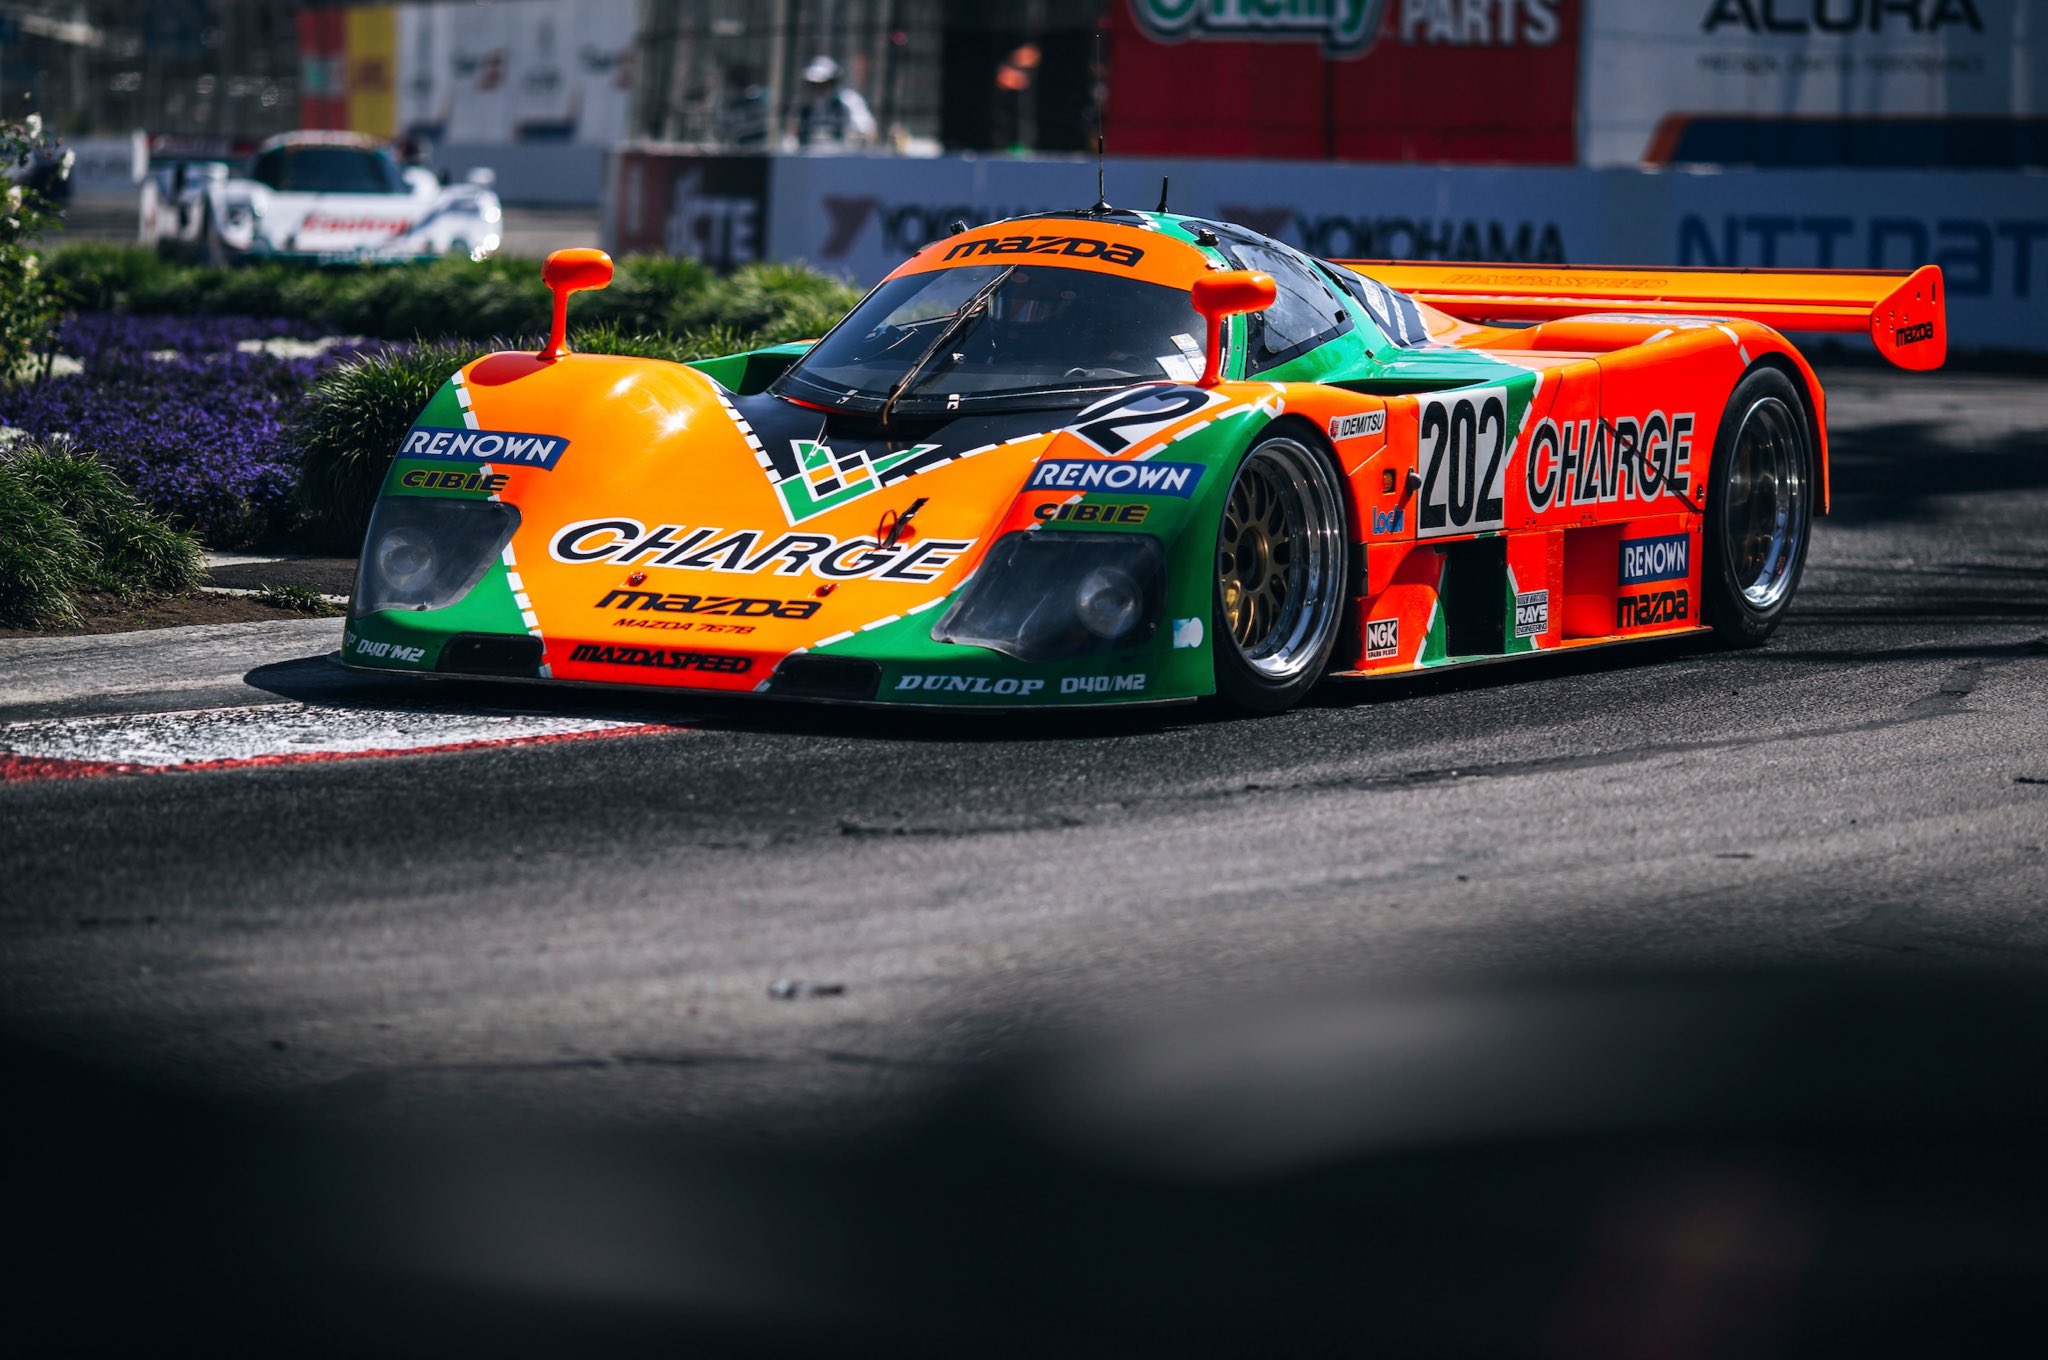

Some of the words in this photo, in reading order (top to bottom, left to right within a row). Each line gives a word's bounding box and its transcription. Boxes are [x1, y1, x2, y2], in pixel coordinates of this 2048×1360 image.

[1403, 0, 1560, 45] PARTS
[1700, 0, 1985, 34] ACURA
[943, 235, 1145, 268] mazda
[1296, 212, 1568, 263] YOKOHAMA
[1678, 213, 1854, 268] NTT
[1896, 322, 1934, 347] mazda
[1341, 413, 1384, 437] IDEMITSU
[402, 431, 557, 463] RENOWN
[1420, 396, 1504, 529] 202
[1526, 409, 1696, 514] CHARGE
[401, 469, 511, 492] CIBIE
[1031, 463, 1192, 492] RENOWN
[1033, 502, 1150, 525] CIBIE
[549, 517, 979, 584] CHARGE
[1623, 539, 1686, 578] RENOWN
[595, 589, 823, 620] mazda
[1517, 604, 1547, 625] RAYS
[1616, 588, 1689, 628] mazda
[612, 618, 694, 631] MAZDA
[696, 623, 756, 635] 767B
[1368, 621, 1397, 650] NGK
[569, 644, 752, 674] MAZDASPEED
[895, 674, 1044, 695] DUNLOP
[1060, 674, 1146, 694] D40/M2
